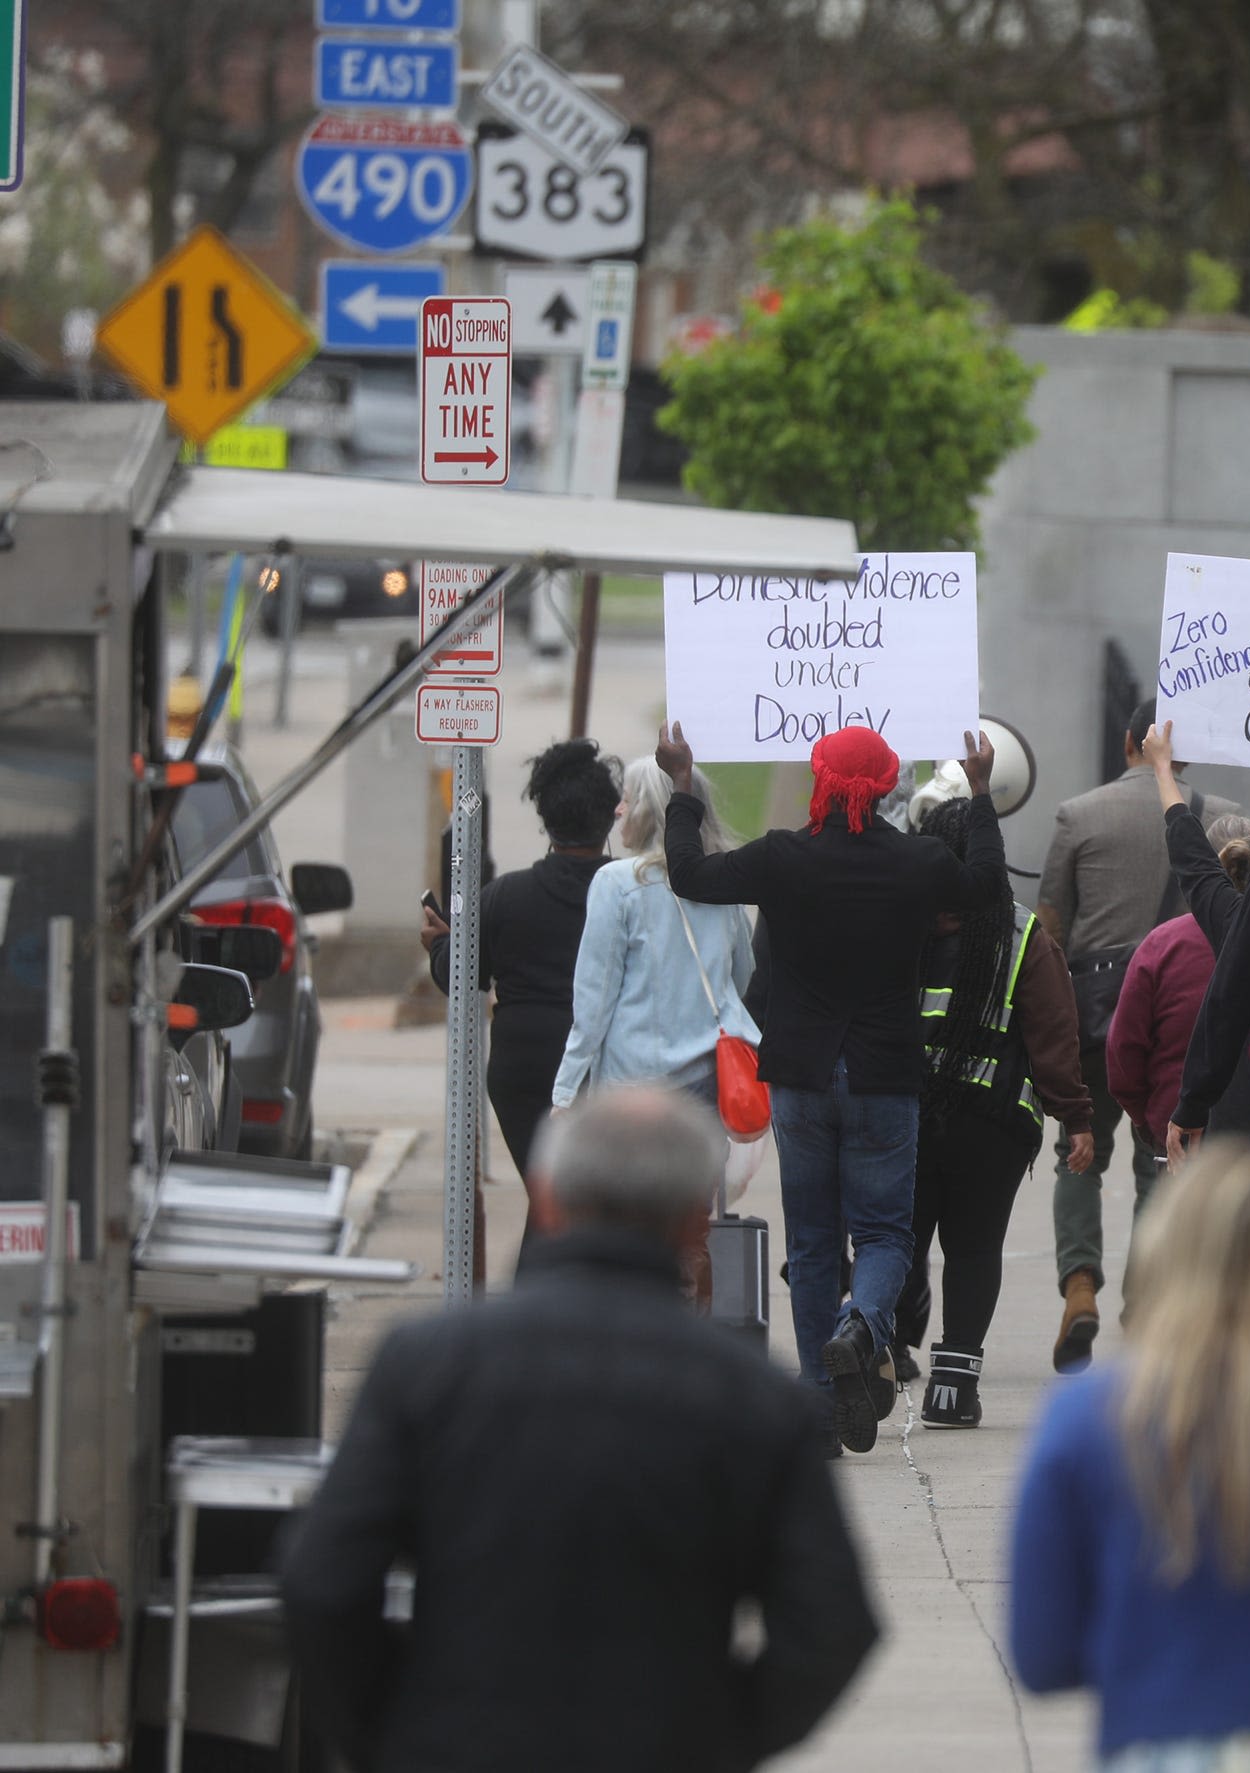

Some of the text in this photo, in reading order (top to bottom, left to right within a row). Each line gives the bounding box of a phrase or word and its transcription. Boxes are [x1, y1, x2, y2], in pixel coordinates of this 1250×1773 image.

[341, 49, 433, 98] EAST
[496, 62, 610, 167] SOUTH
[315, 153, 455, 223] 490
[492, 162, 630, 225] 383
[427, 313, 506, 348] NO STOPPING
[443, 362, 492, 395] ANY
[439, 405, 494, 438] TIME
[429, 568, 468, 583] LOADING
[844, 553, 960, 601] Violence
[767, 600, 884, 650] doubled
[1167, 611, 1227, 653] Zero
[774, 652, 875, 689] under
[424, 698, 494, 712] 4 WAY FLASHERS
[440, 718, 479, 731] REQUIRED
